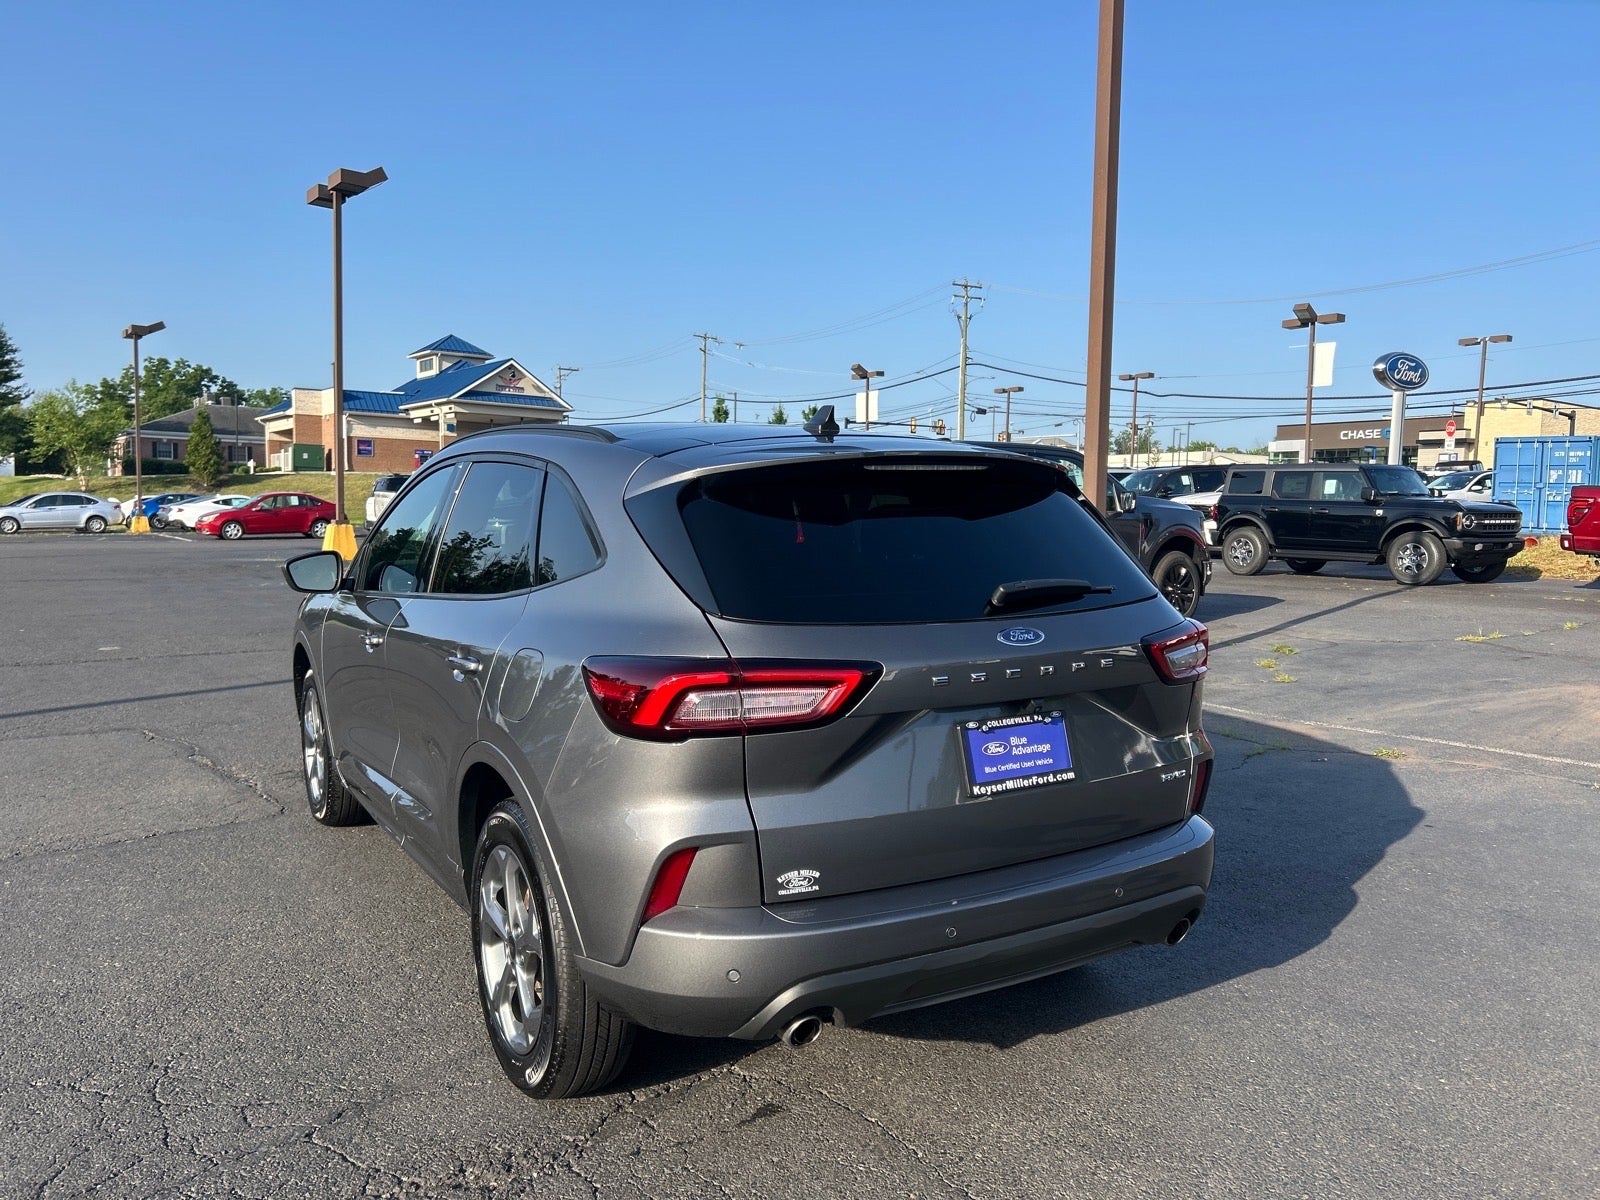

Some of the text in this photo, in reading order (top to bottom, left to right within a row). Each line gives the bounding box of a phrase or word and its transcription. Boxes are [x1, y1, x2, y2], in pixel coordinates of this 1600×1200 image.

[1395, 359, 1422, 383] Ford
[1340, 429, 1382, 440] CHASE
[1010, 629, 1036, 641] Ford
[932, 658, 1113, 687] ESCAPE
[987, 716, 1033, 728] COLLEGEVILLE,
[1010, 736, 1028, 746] Blue
[987, 743, 1005, 754] Ford
[1012, 743, 1051, 756] Advantage
[984, 757, 1053, 774] Blue Certified Used Vehicle
[973, 771, 1075, 795] KeyserMillerFord.com
[800, 870, 820, 878] MILLER
[789, 877, 809, 887] Ford
